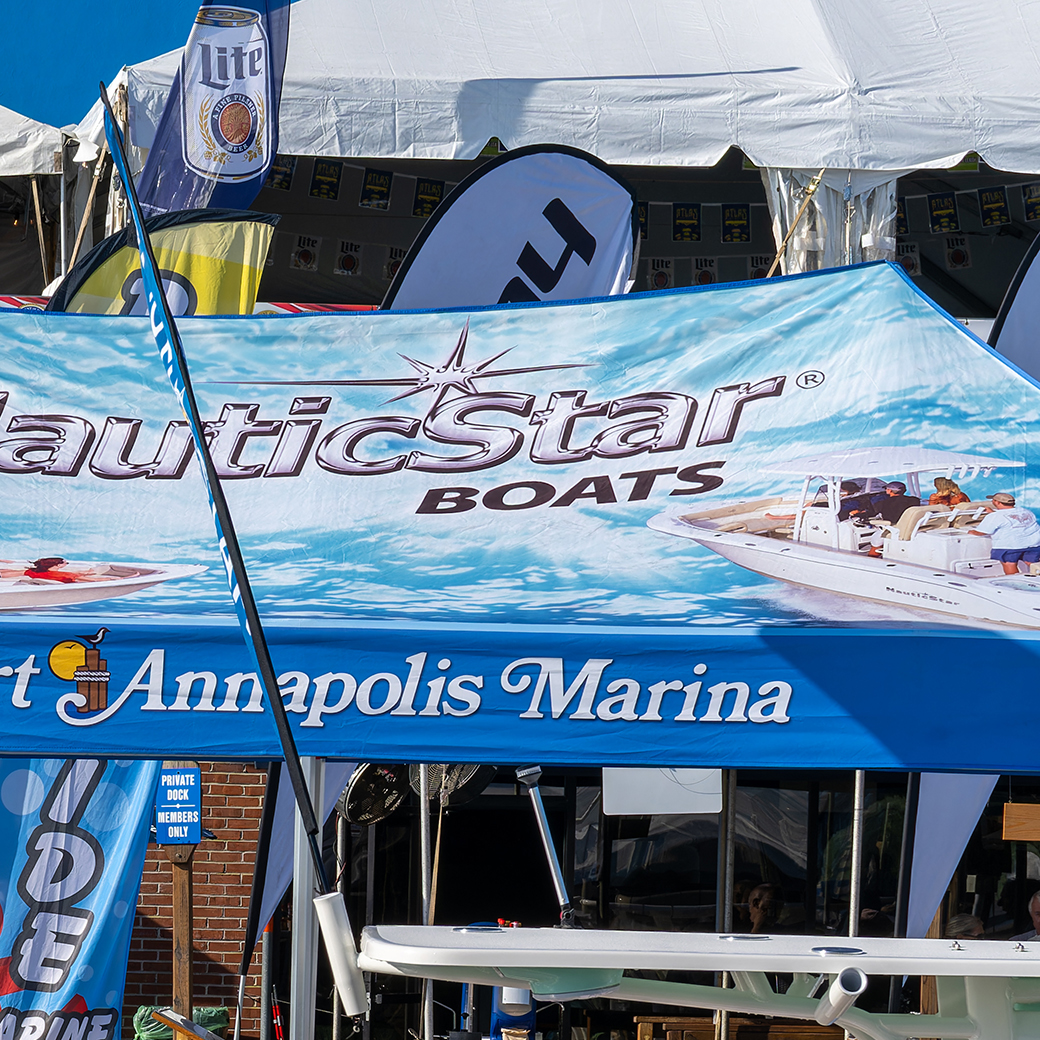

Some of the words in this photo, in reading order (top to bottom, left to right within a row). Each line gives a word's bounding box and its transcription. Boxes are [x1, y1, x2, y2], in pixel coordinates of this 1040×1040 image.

[197, 42, 262, 91] Lite
[215, 96, 232, 113] FINE
[233, 94, 257, 118] PILSNER
[297, 235, 318, 249] Lite
[340, 240, 361, 254] Lite
[946, 236, 966, 250] Lite
[651, 258, 671, 271] Lite
[695, 257, 715, 270] Lite
[750, 255, 770, 268] Lite
[415, 460, 726, 515] BOATS
[885, 585, 959, 607] NauticStar
[55, 648, 485, 727] Annapolis
[500, 656, 795, 723] Marina
[161, 774, 196, 787] PRIVATE
[166, 788, 190, 801] DOCK
[157, 811, 200, 824] MEMBERS
[167, 825, 190, 838] ONLY
